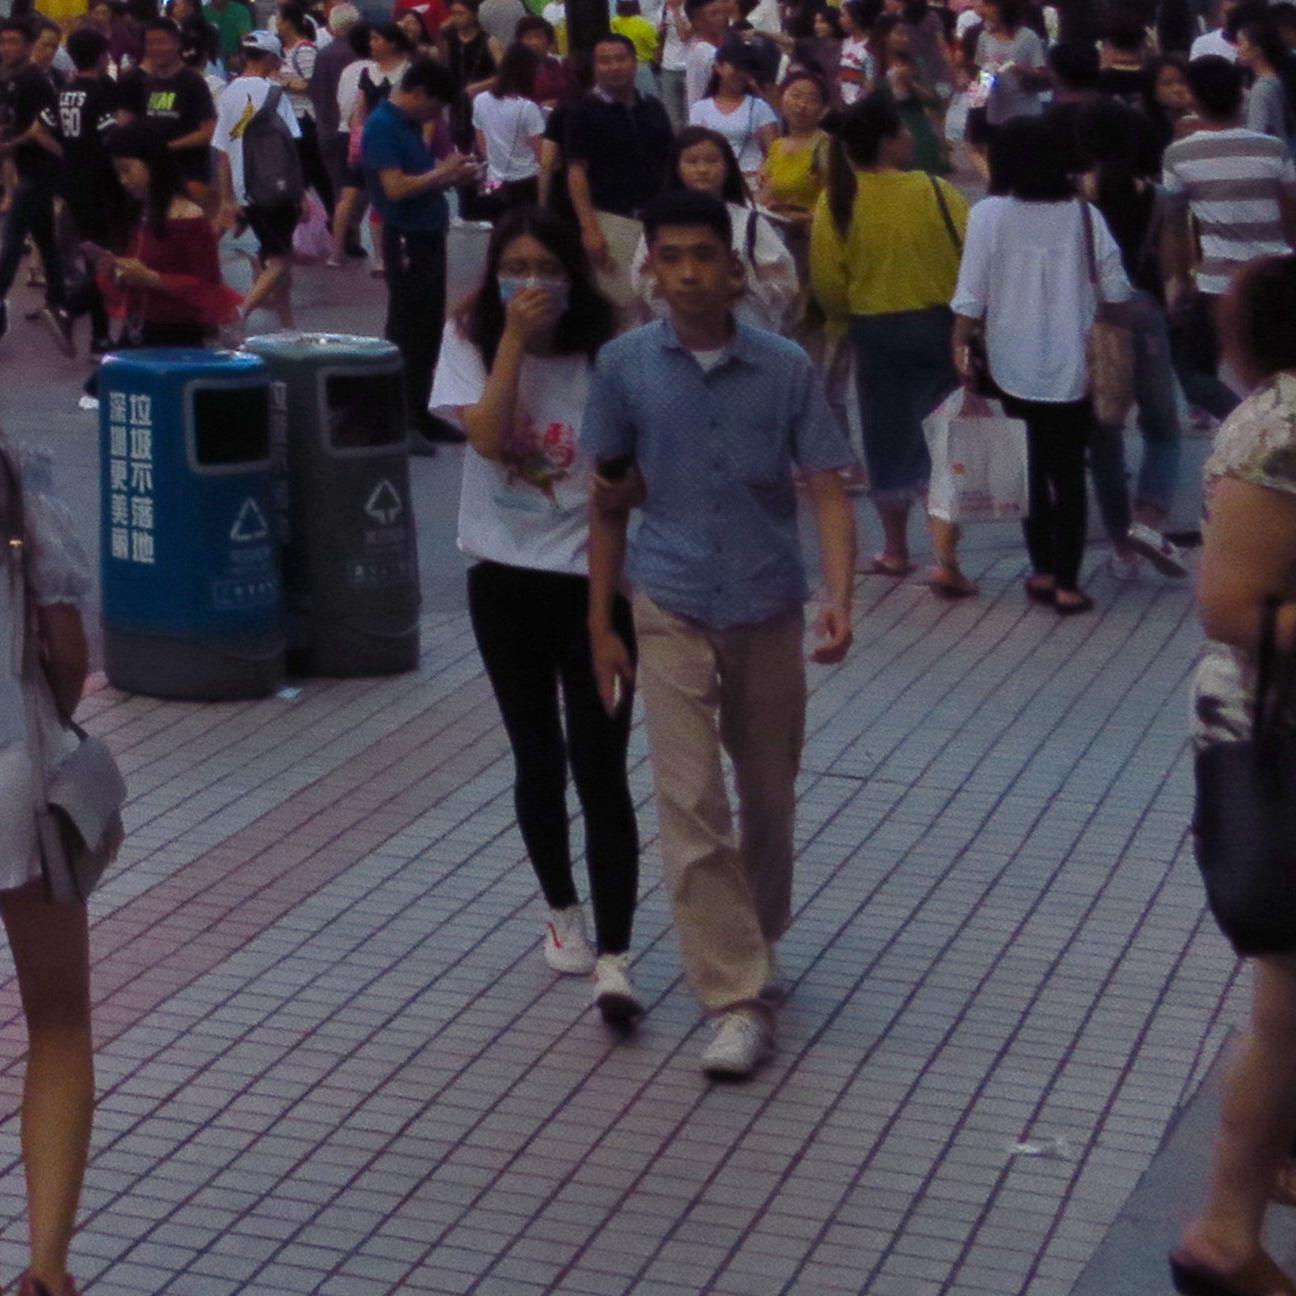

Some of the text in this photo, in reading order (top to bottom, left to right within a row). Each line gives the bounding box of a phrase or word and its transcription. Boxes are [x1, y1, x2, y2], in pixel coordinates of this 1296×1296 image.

[129, 391, 156, 565] 垃圾不落地
